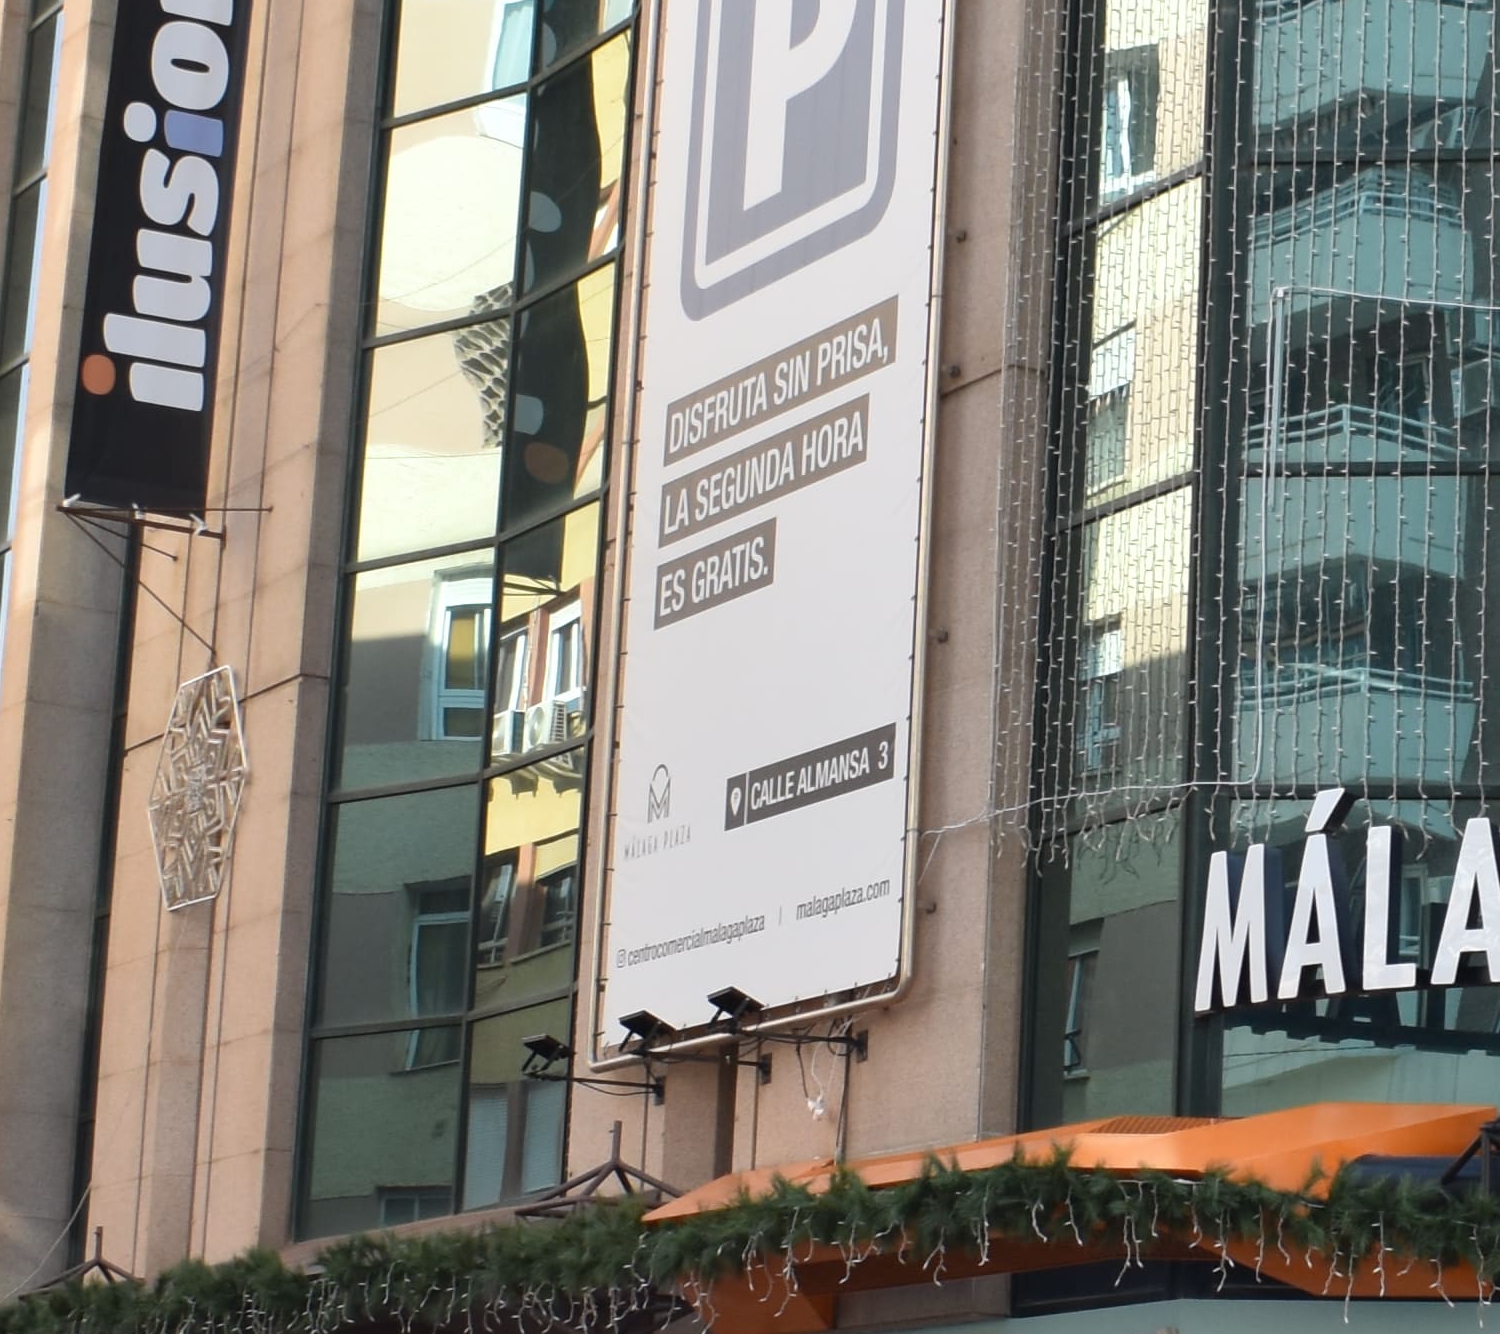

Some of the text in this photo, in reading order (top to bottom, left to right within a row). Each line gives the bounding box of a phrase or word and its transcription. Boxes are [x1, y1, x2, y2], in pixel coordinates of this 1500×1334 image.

[668, 317, 889, 455] DISFRUTA SIN PRISA,
[663, 411, 864, 535] LA SEGUNDA HORA
[659, 536, 769, 617] ES GRATIS.
[750, 740, 890, 812] CALLE ALMANSA 3
[796, 876, 891, 922] malagaplaza.com
